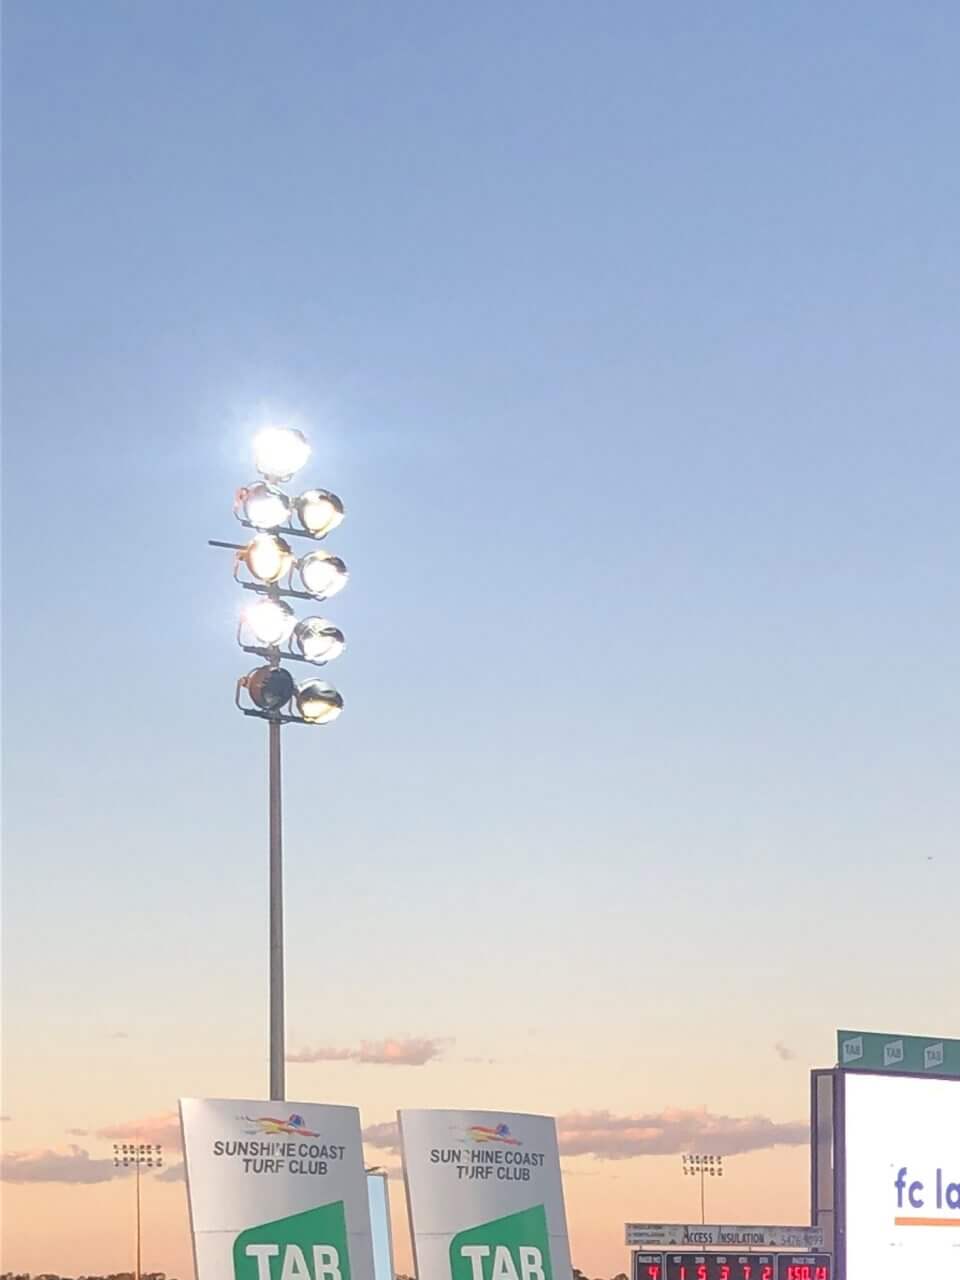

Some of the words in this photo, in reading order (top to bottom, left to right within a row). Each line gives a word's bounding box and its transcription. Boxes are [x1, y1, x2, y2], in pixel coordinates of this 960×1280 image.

[213, 1141, 296, 1157] SUNSHINE
[298, 1144, 346, 1159] COAST
[242, 1158, 285, 1173] TURF
[288, 1160, 328, 1175] CLUB
[504, 1152, 545, 1166] COAST
[456, 1166, 493, 1179] TURF
[496, 1167, 530, 1181] CLUB
[894, 1167, 924, 1209] fc
[680, 1266, 686, 1280] 1
[743, 1266, 752, 1280] 7
